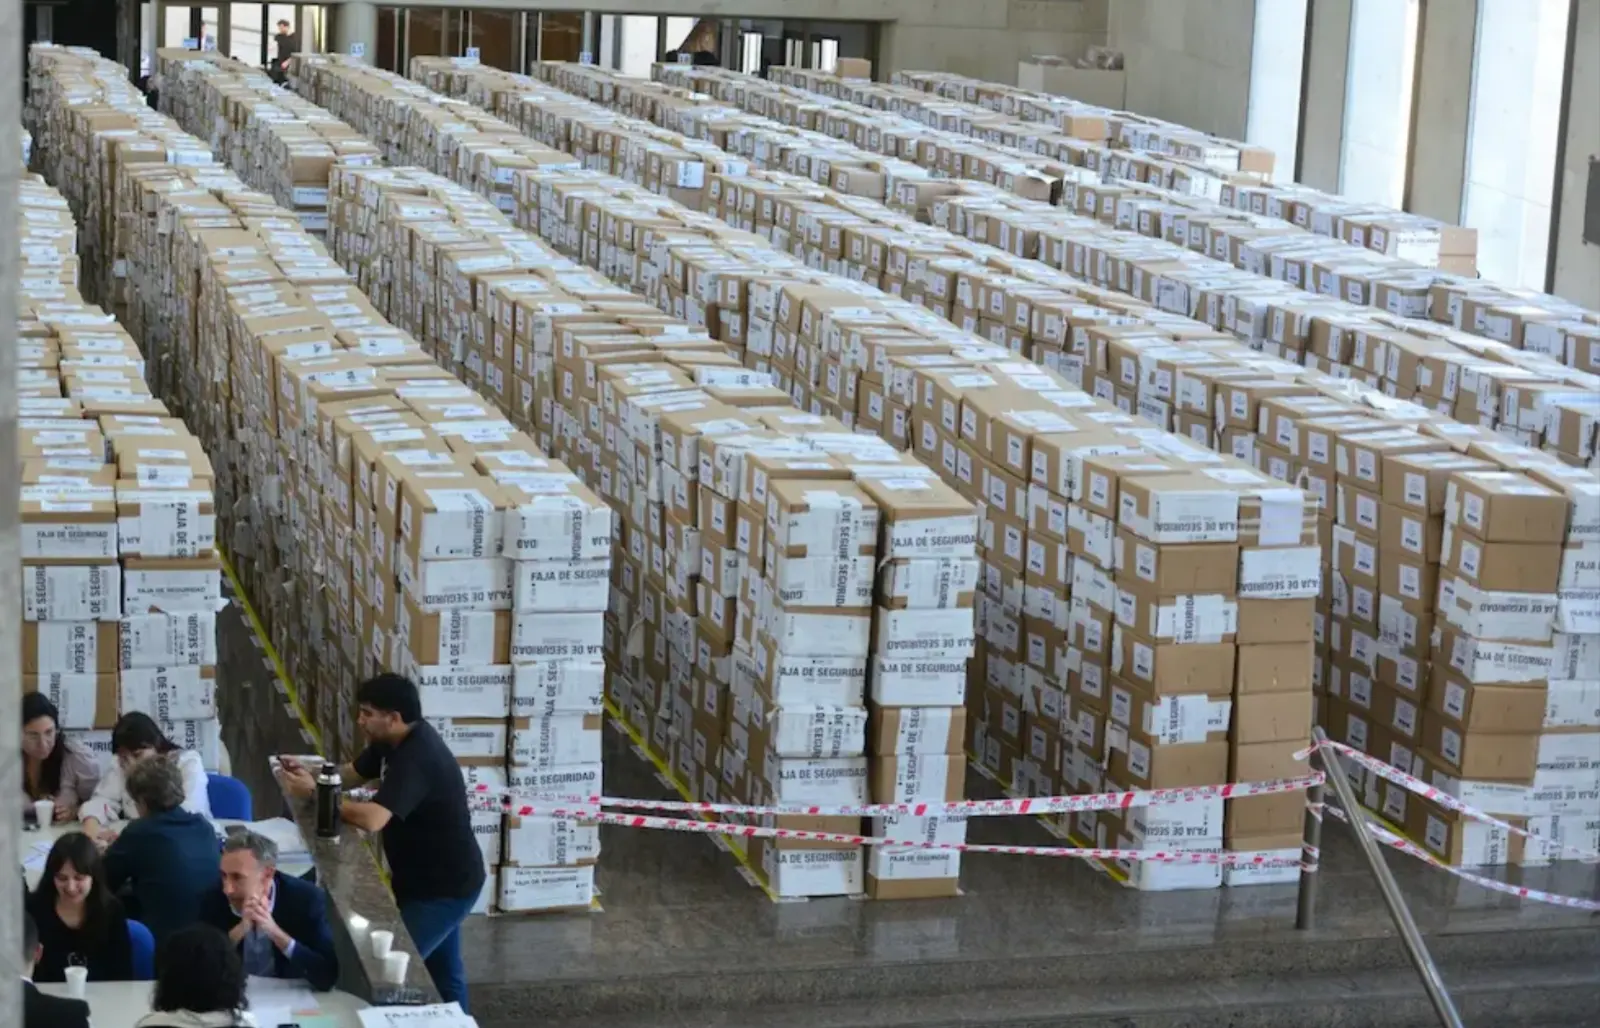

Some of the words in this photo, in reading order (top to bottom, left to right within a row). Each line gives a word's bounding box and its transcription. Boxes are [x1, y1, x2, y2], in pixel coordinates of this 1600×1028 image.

[559, 570, 572, 580] DE
[802, 666, 815, 677] DE
[901, 663, 912, 673] DE
[441, 675, 454, 686] DE
[524, 776, 538, 786] DE
[540, 771, 596, 784] SEGURIDAD
[799, 769, 811, 779] DE
[790, 854, 802, 864] DE
